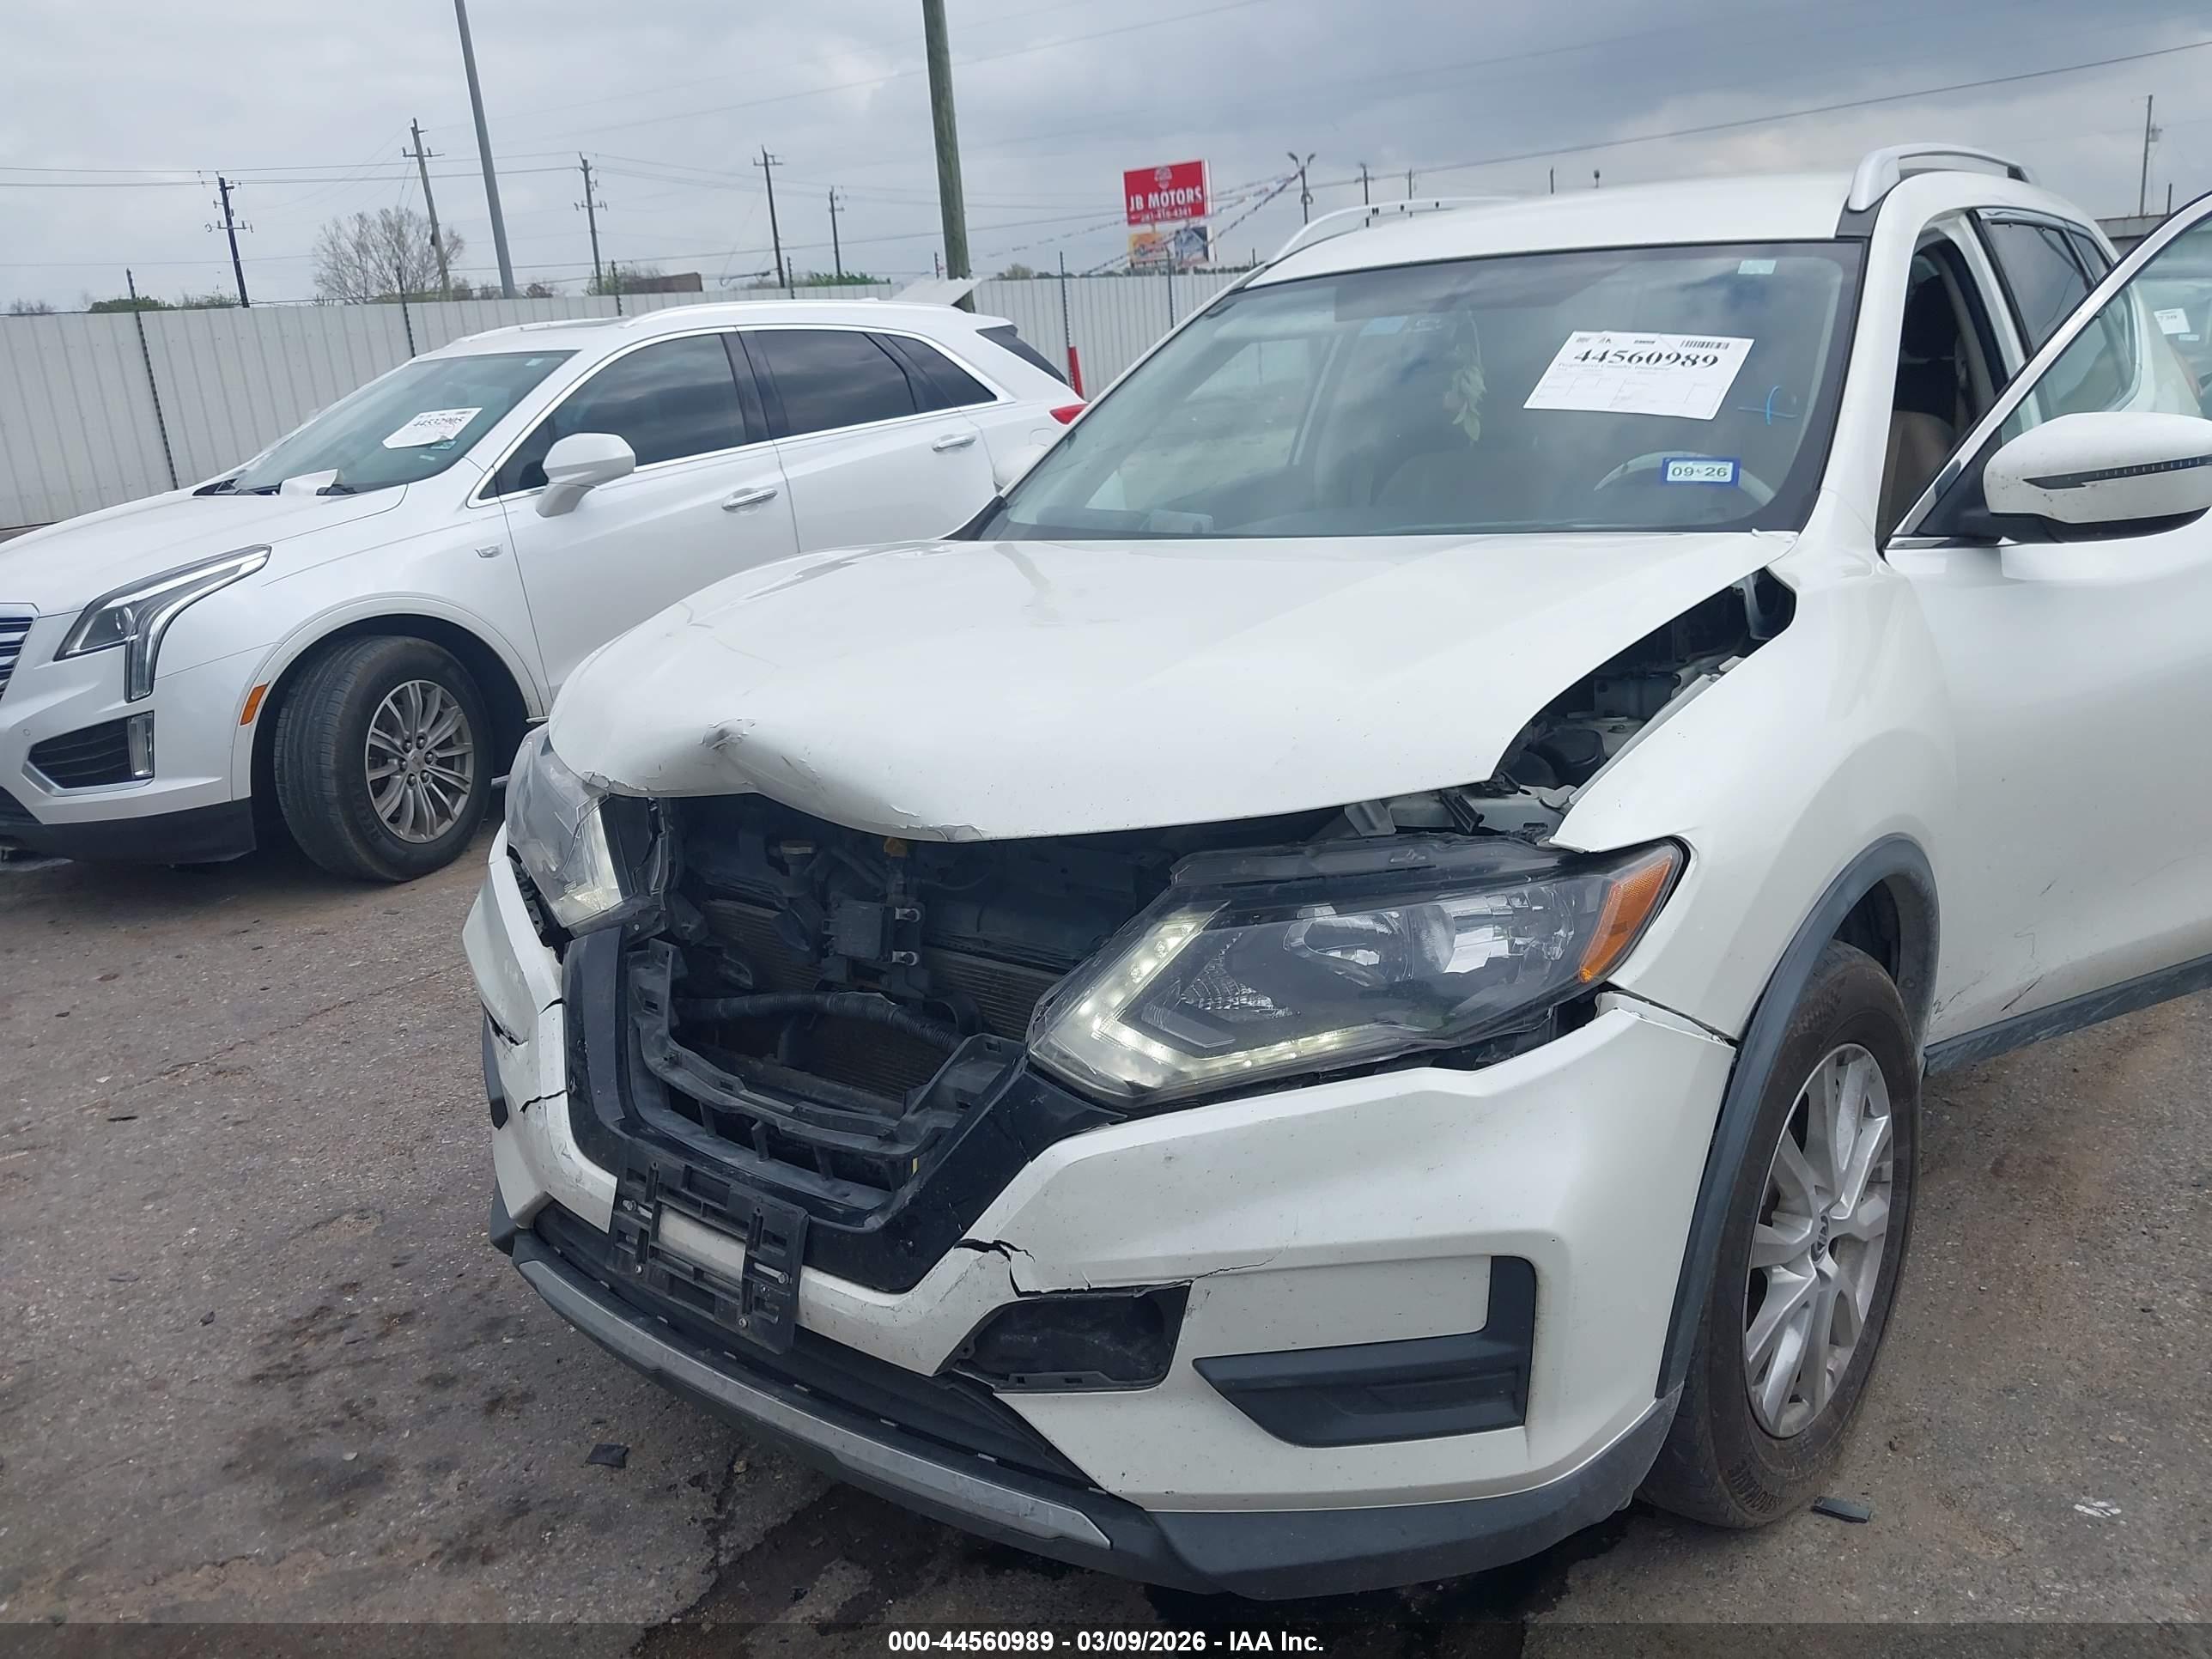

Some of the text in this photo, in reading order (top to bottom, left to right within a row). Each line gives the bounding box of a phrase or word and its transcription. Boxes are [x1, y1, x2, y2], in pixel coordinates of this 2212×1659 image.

[1129, 185, 1202, 212] JB MOTORS
[1573, 349, 1718, 368] 44560989
[1671, 466, 1728, 477] 09 26
